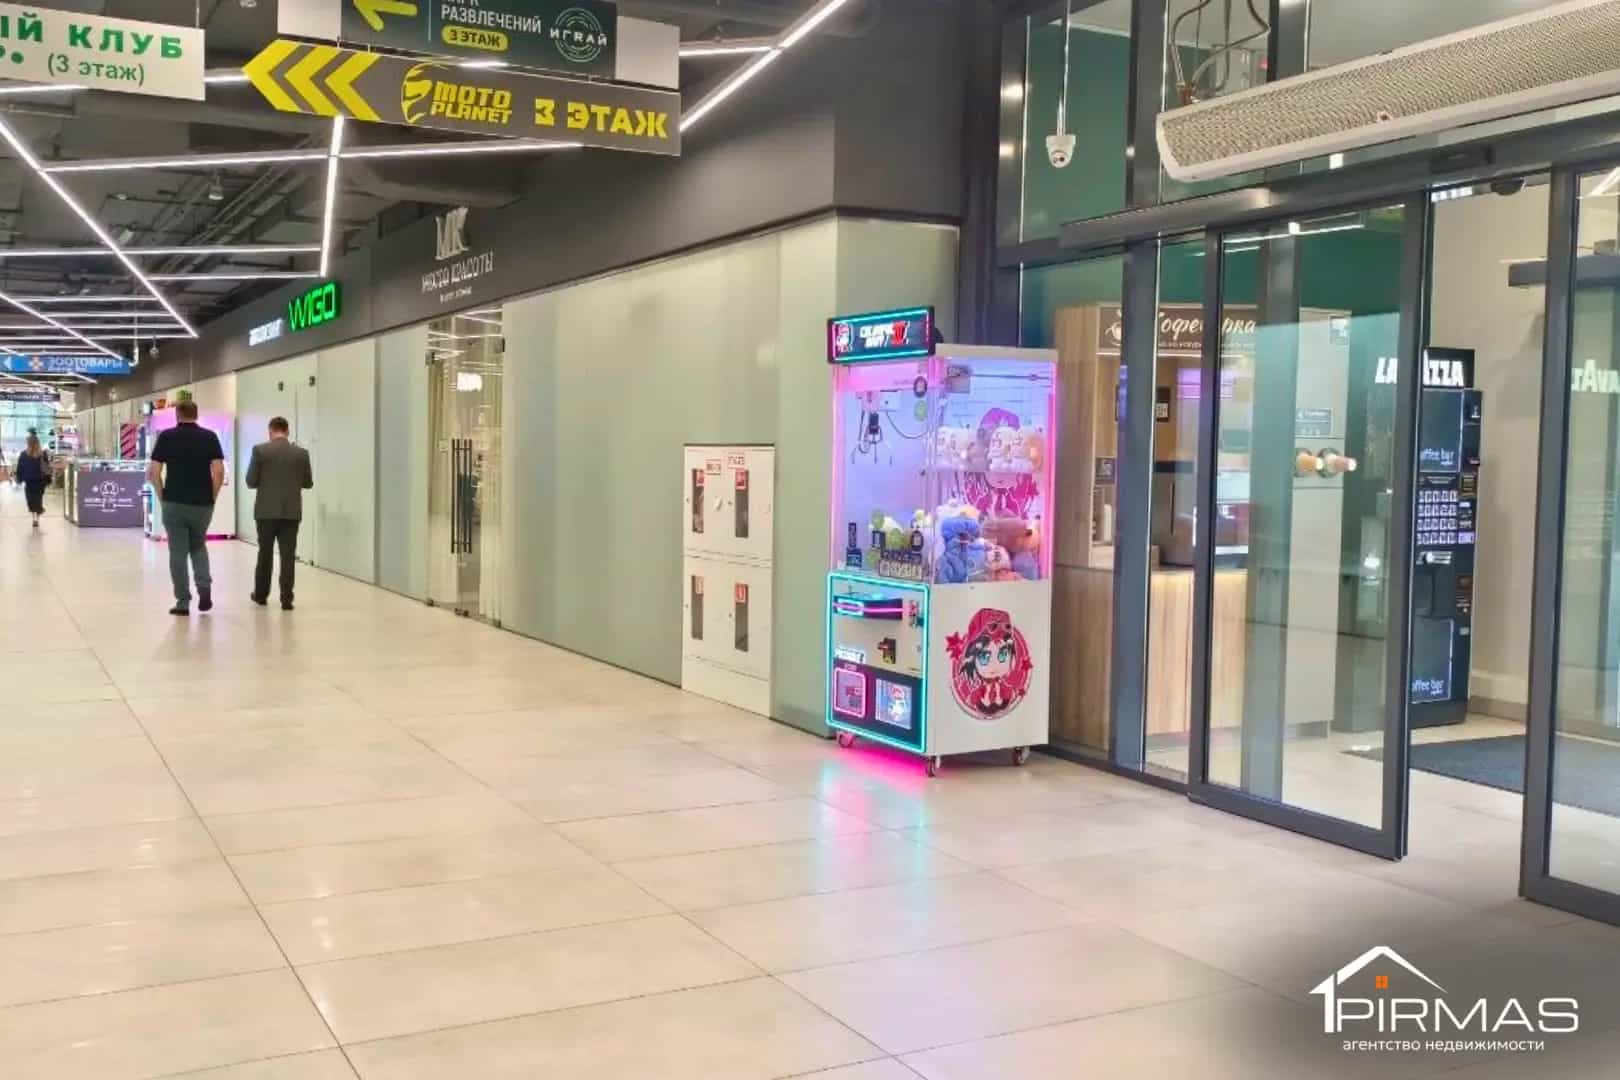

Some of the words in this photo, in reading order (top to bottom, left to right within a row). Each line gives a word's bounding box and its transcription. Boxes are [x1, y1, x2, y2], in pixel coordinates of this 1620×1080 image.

[441, 5, 543, 33] РАЗВЛЕЧЕНИЙ
[68, 24, 183, 58] КЛУБ
[450, 29, 459, 41] 3
[461, 31, 501, 48] ЭТАЖ
[48, 53, 70, 77] (3
[79, 61, 145, 86] этаж)
[433, 81, 512, 109] MOTO
[430, 101, 513, 125] PLANET
[534, 97, 556, 126] 3
[567, 101, 669, 139] ЭТАЖ
[288, 282, 336, 331] WIGO
